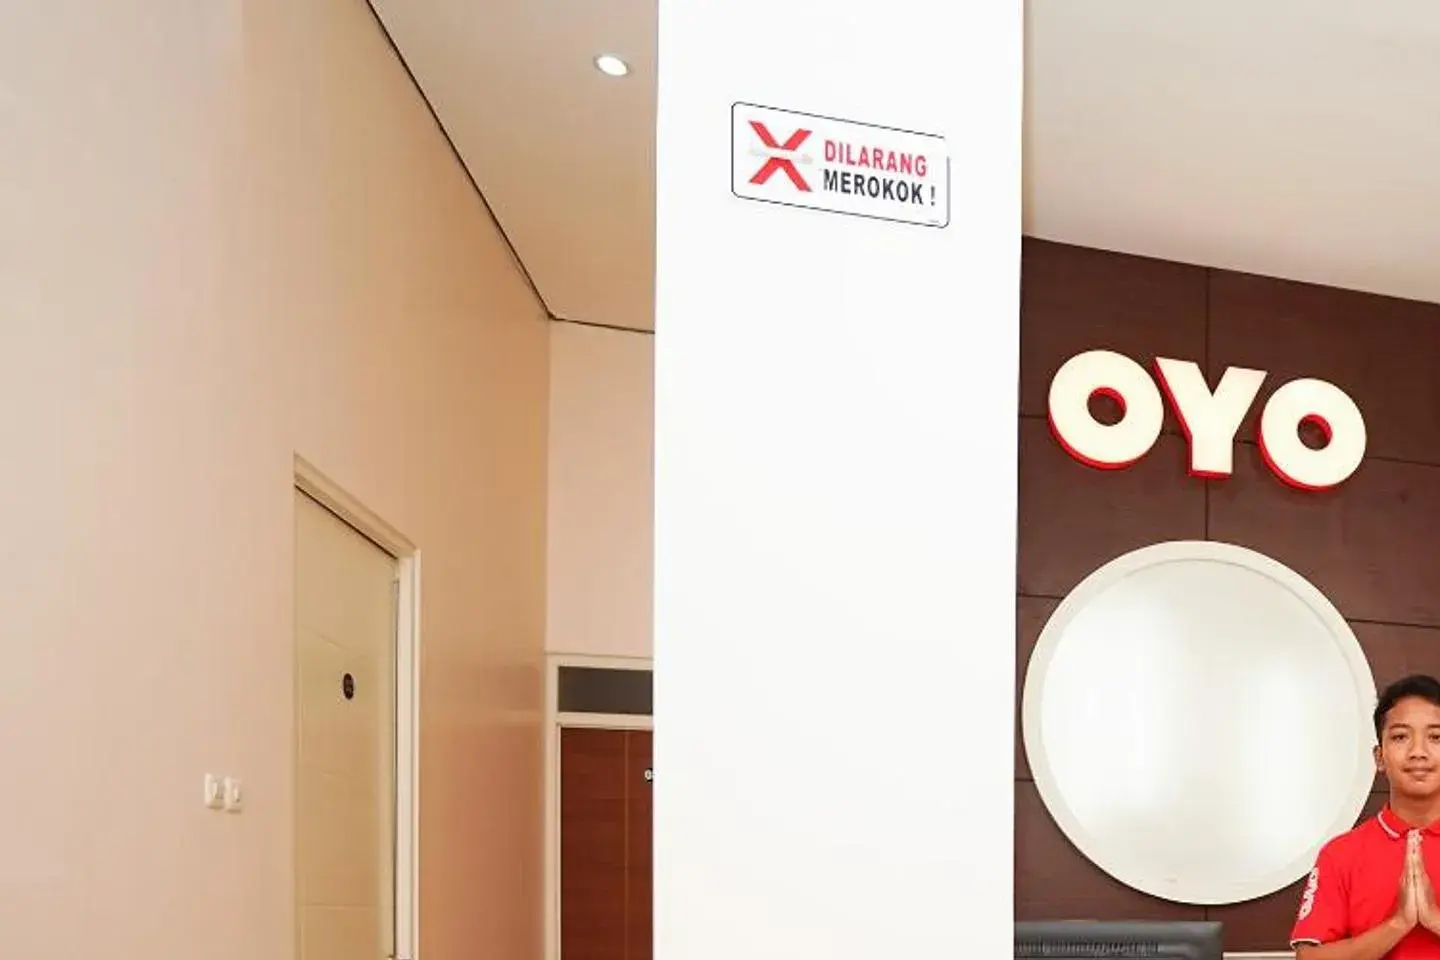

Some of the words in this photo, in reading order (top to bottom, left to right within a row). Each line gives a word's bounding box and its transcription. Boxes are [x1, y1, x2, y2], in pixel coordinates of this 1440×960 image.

[824, 139, 928, 178] DILARANG
[823, 168, 925, 206] MEROKOK
[1048, 350, 1367, 492] OYO
